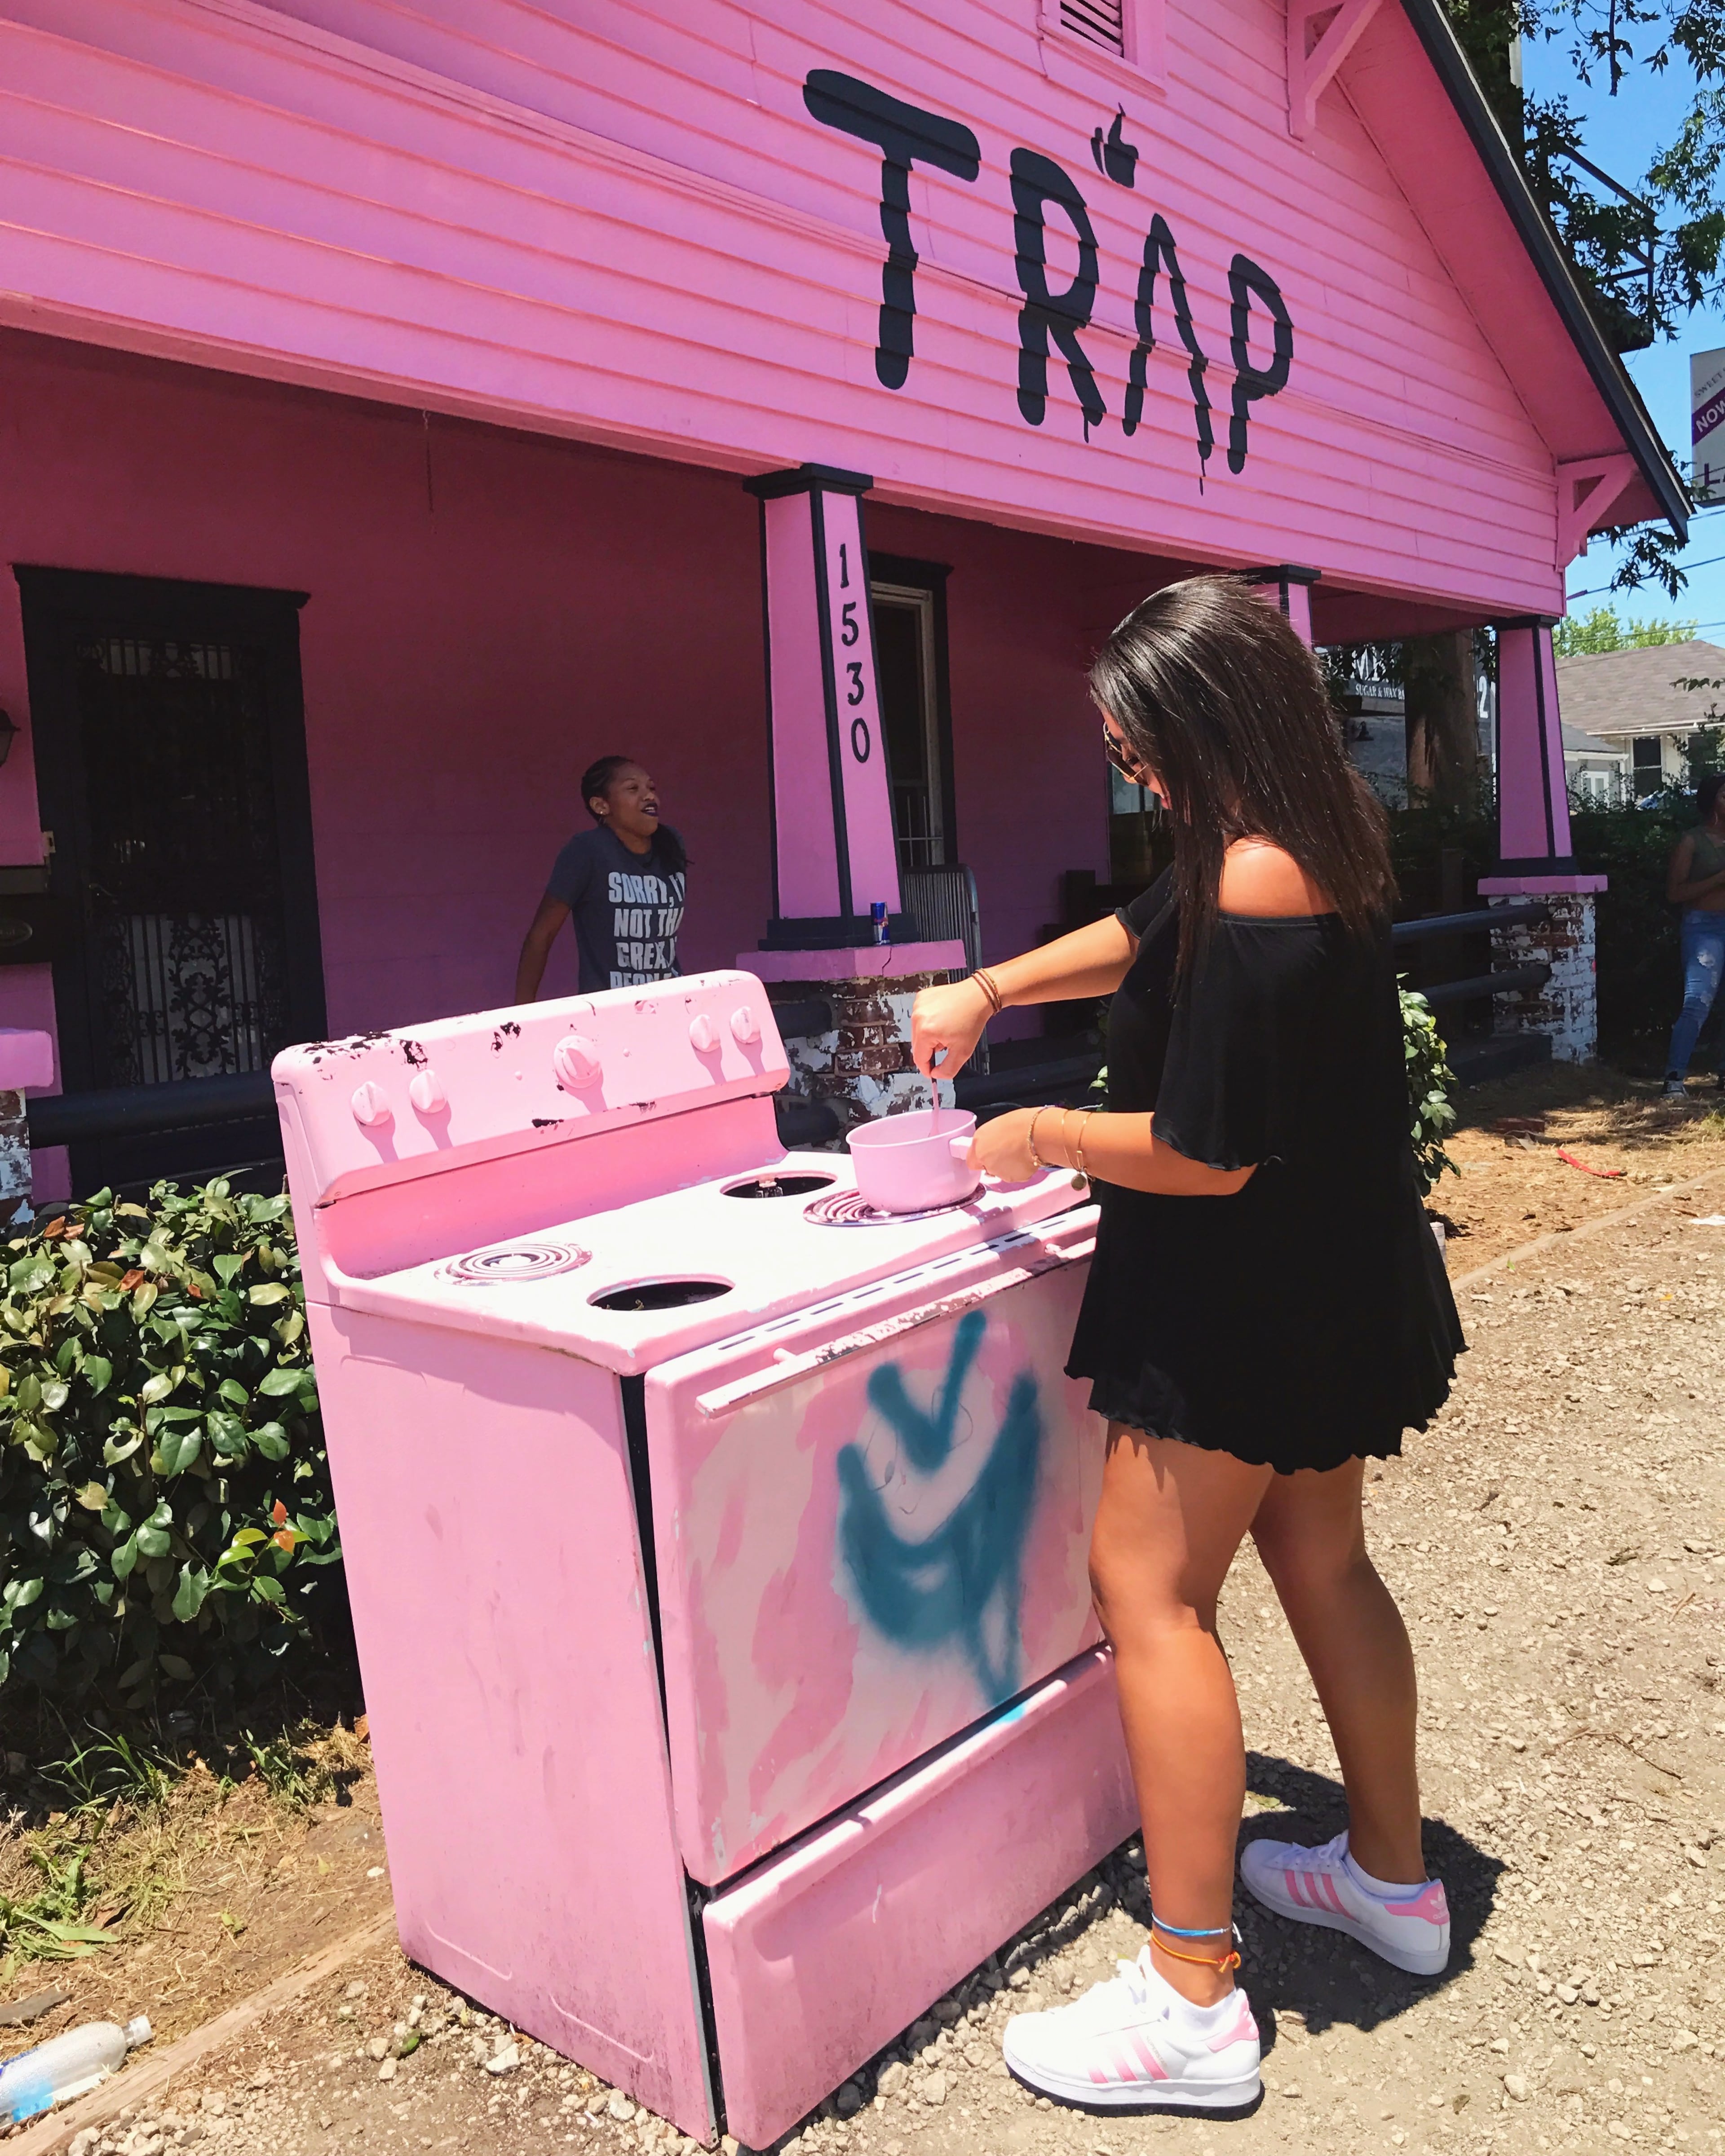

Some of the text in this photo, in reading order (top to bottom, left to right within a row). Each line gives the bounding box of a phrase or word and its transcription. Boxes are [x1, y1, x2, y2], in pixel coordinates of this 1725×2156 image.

[802, 69, 1293, 495] TRAP
[839, 543, 870, 763] 1530
[1355, 683, 1376, 697] SUGAR
[1383, 687, 1397, 698] WAX
[1477, 676, 1489, 719] 2
[614, 908, 652, 938] NOT
